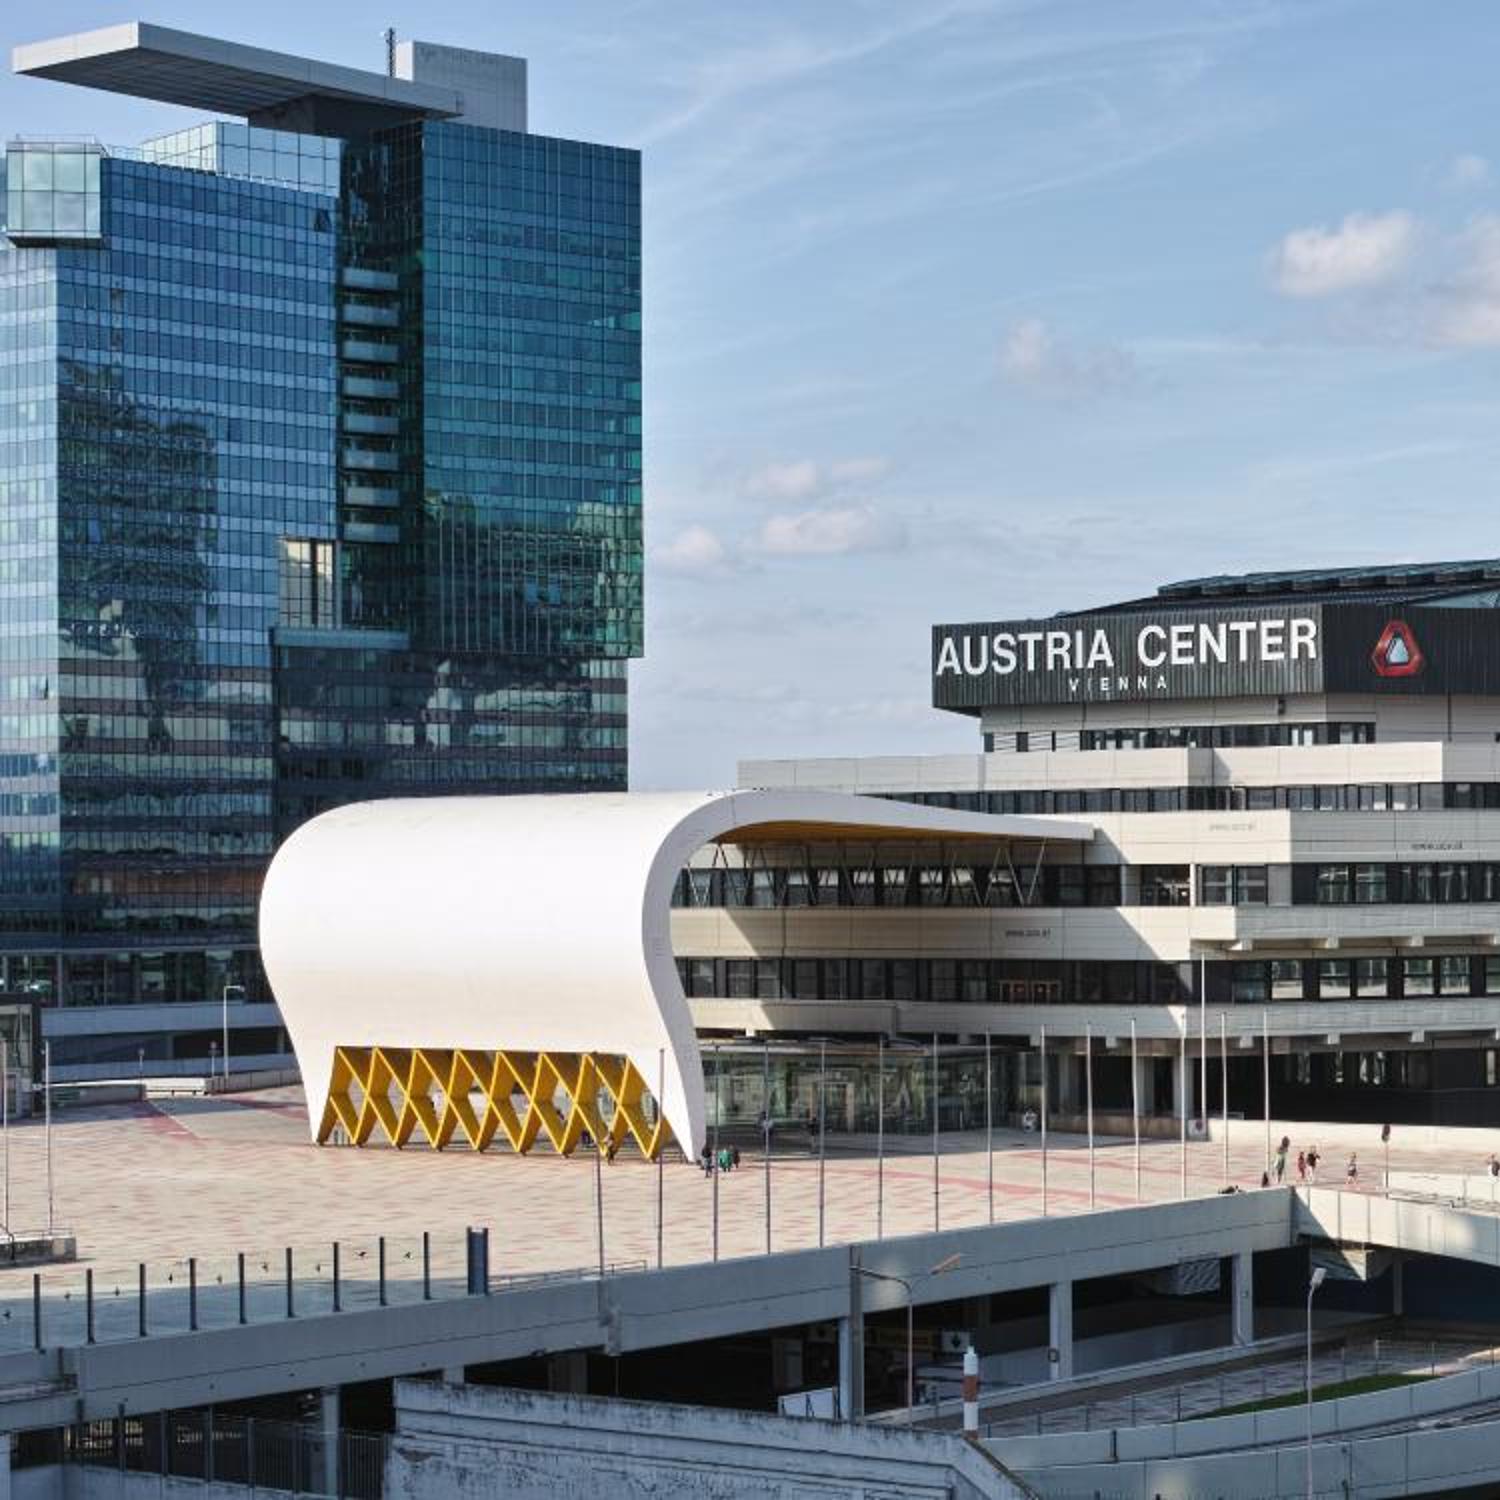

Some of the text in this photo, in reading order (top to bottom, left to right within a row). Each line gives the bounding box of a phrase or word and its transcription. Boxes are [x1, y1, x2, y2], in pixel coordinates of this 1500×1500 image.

[935, 618, 1317, 676] AUSTRIA CENTER
[1069, 675, 1167, 692] VIENNA
